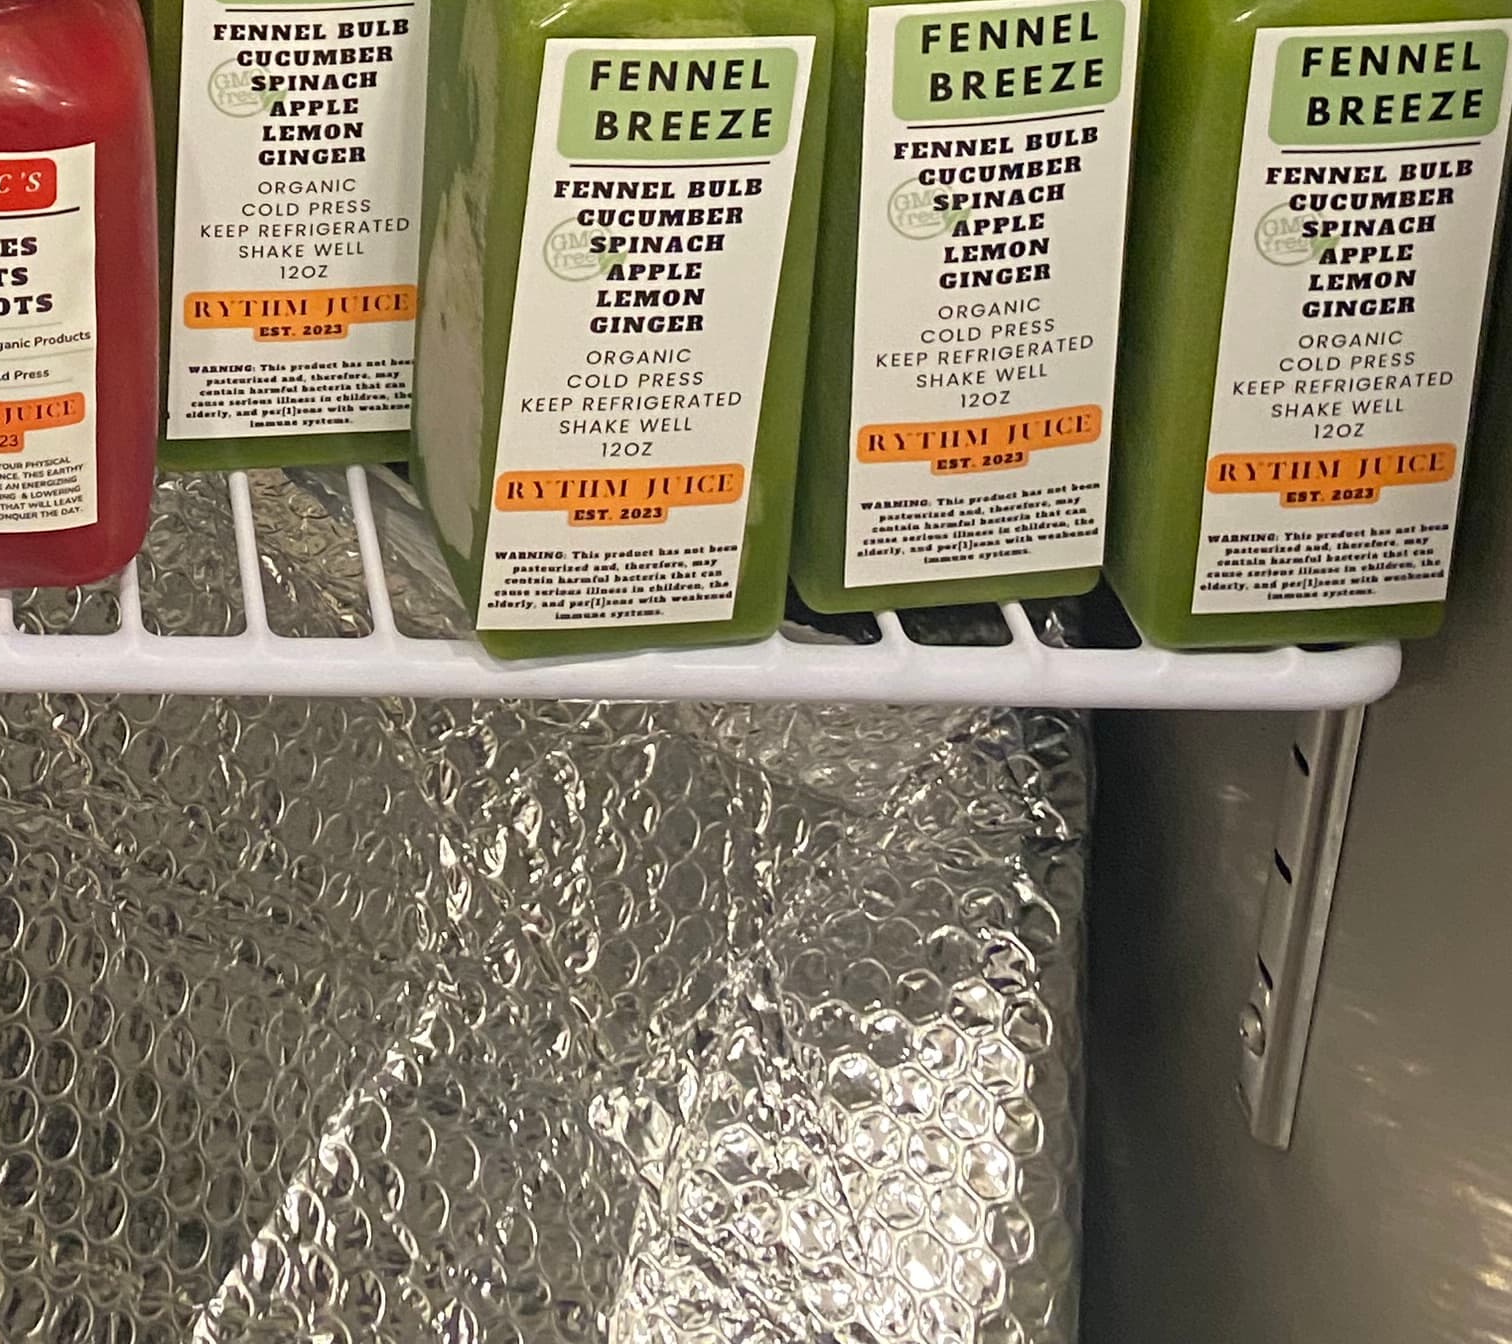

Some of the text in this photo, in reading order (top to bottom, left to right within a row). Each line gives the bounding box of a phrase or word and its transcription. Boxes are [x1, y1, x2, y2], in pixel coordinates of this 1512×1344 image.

[213, 19, 409, 41] FENNEL BULB
[921, 12, 1099, 54] FENNEL
[237, 46, 393, 66] CUCUMBER
[1301, 41, 1481, 77] FENNEL
[251, 71, 378, 92] SPINACH
[590, 59, 771, 91] FENNEL
[930, 58, 1103, 102] BREEZE
[1306, 89, 1483, 126] BREEZE
[262, 122, 364, 142] LEMON
[595, 108, 772, 141] BREEZE
[918, 156, 1081, 186] CUCUMBER
[200, 218, 410, 238] KEEP REFRIGERATED
[1319, 244, 1414, 265] APPLE
[606, 262, 703, 280] APPLE
[939, 263, 1051, 290] GINGER
[1302, 296, 1416, 319] GINGER
[586, 349, 692, 365] ORGANIC
[14, 368, 50, 380] Press
[567, 372, 704, 388] COLD PRESS
[916, 363, 1048, 388] SHAKE WELL
[1314, 423, 1364, 439] 12OZ
[507, 473, 734, 499] RYTHM JUICE
